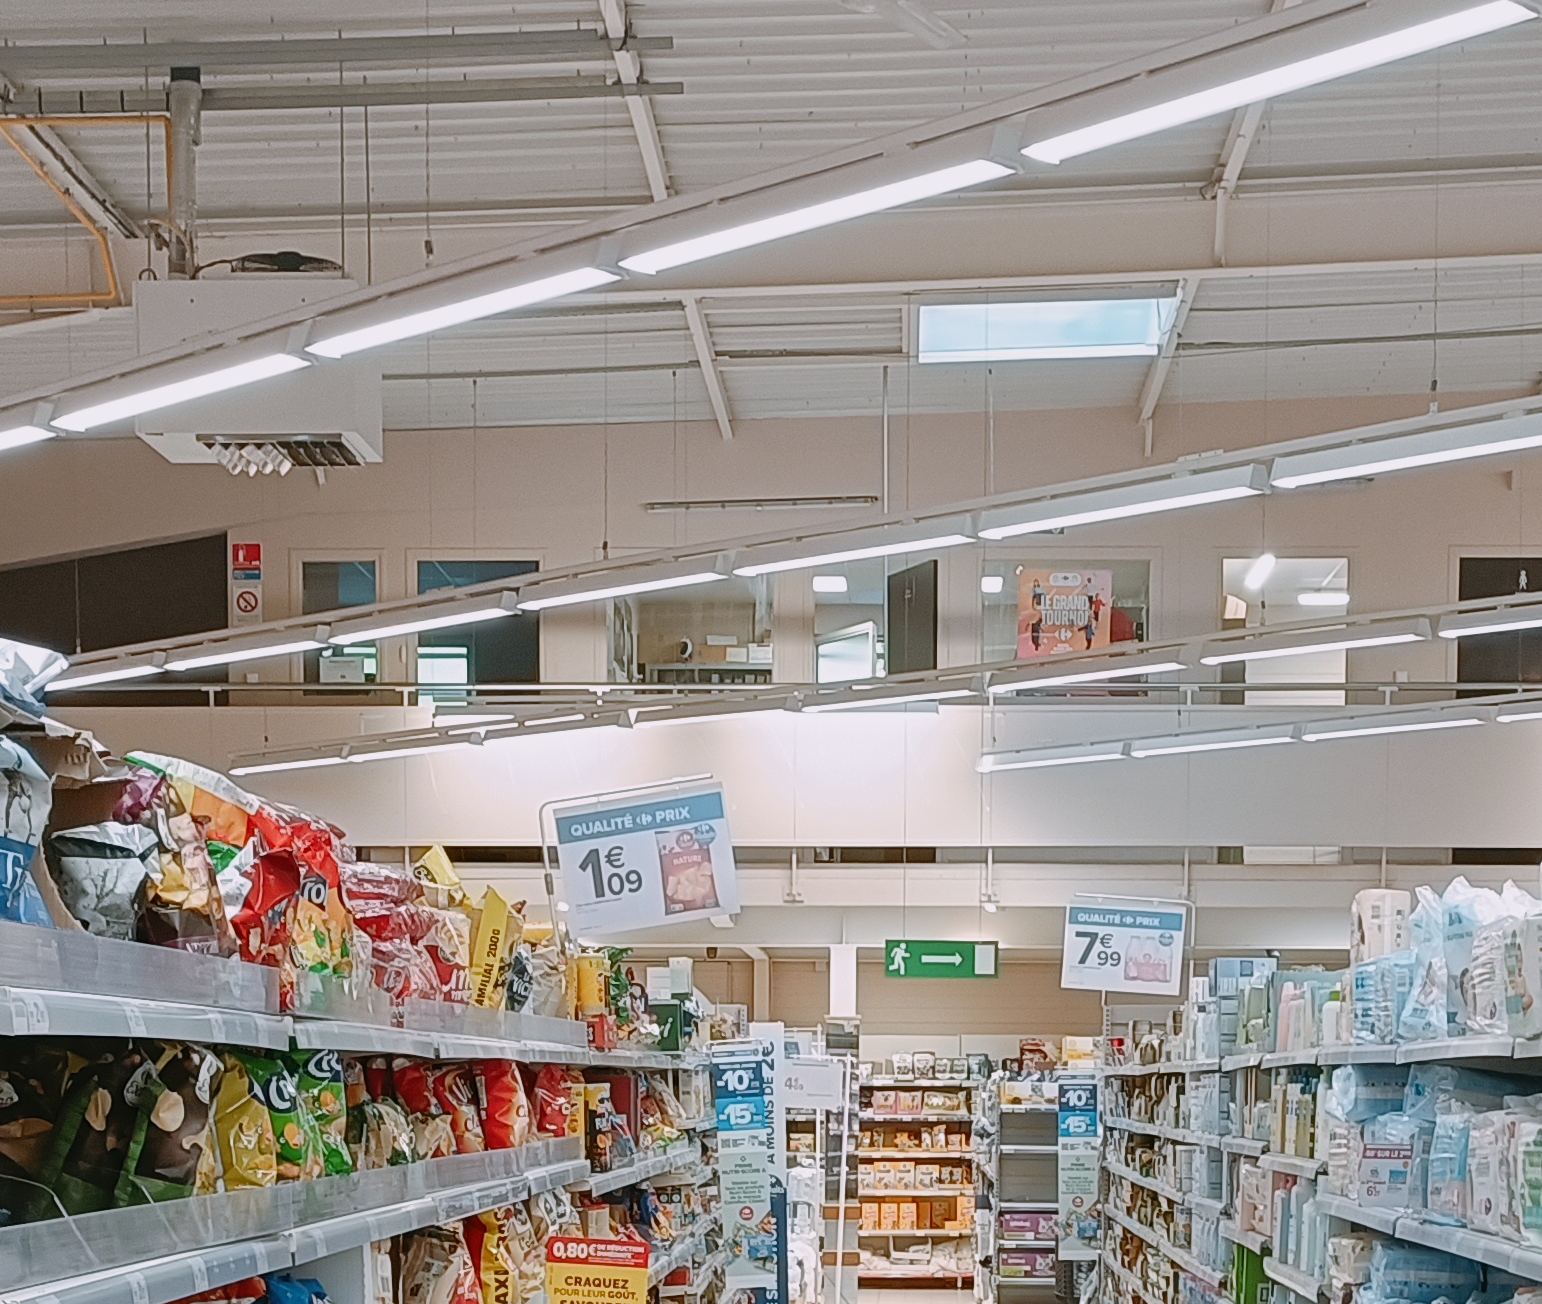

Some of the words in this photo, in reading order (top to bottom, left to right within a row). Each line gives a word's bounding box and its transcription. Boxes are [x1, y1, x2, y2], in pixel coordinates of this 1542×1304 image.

[1053, 594, 1089, 610] GRAND
[1041, 610, 1089, 626] TOURNOI
[571, 813, 634, 837] QUALITÉ
[656, 806, 691, 824] PRIX
[1077, 912, 1121, 924] QUALITÉ
[1136, 916, 1161, 927] PRIX
[763, 1077, 774, 1096] DE
[553, 1241, 596, 1259] 0,80€
[564, 1276, 629, 1290] CRAQUEZ
[554, 1287, 579, 1296] POUR
[581, 1289, 606, 1298] LEUR
